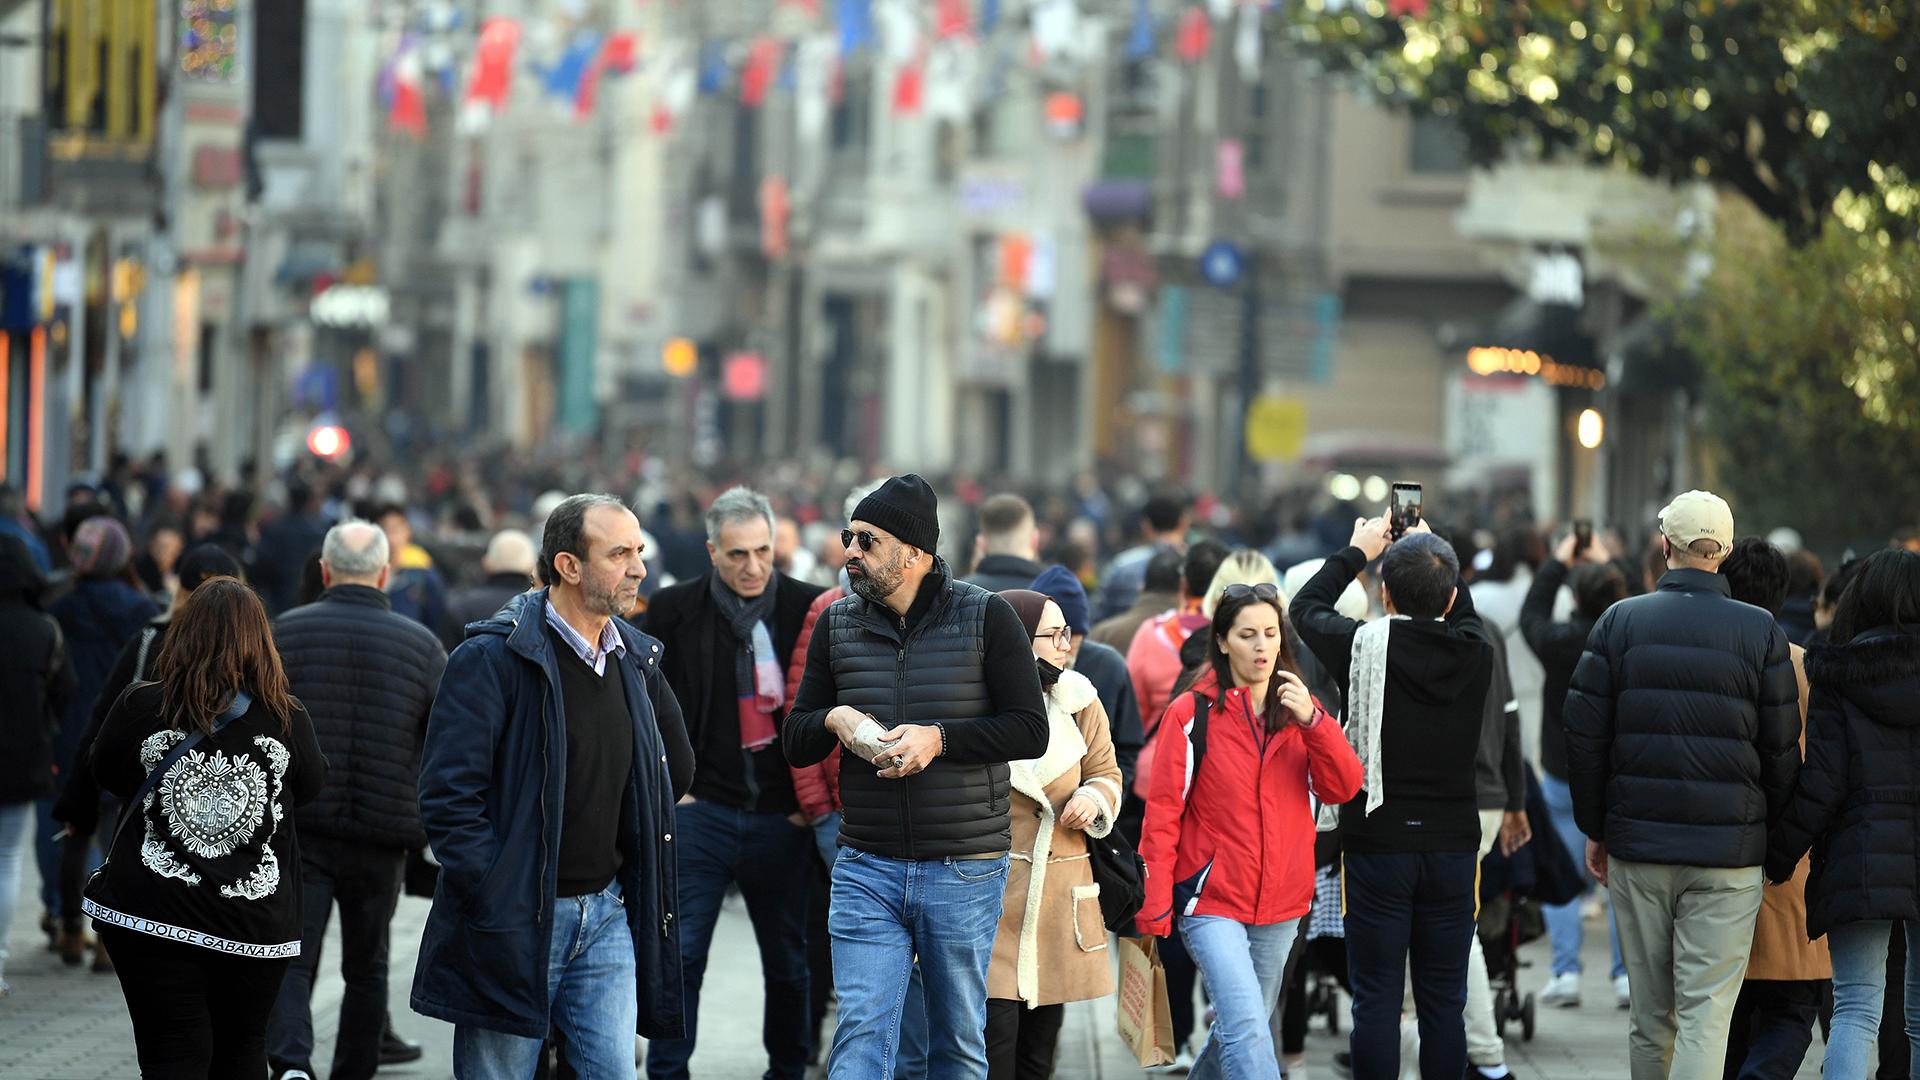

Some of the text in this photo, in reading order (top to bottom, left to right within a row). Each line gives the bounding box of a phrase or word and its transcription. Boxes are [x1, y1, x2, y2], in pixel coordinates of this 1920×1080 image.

[95, 905, 141, 928] BEAUTY
[145, 921, 198, 943] DOLCE
[202, 936, 265, 957] GABANA
